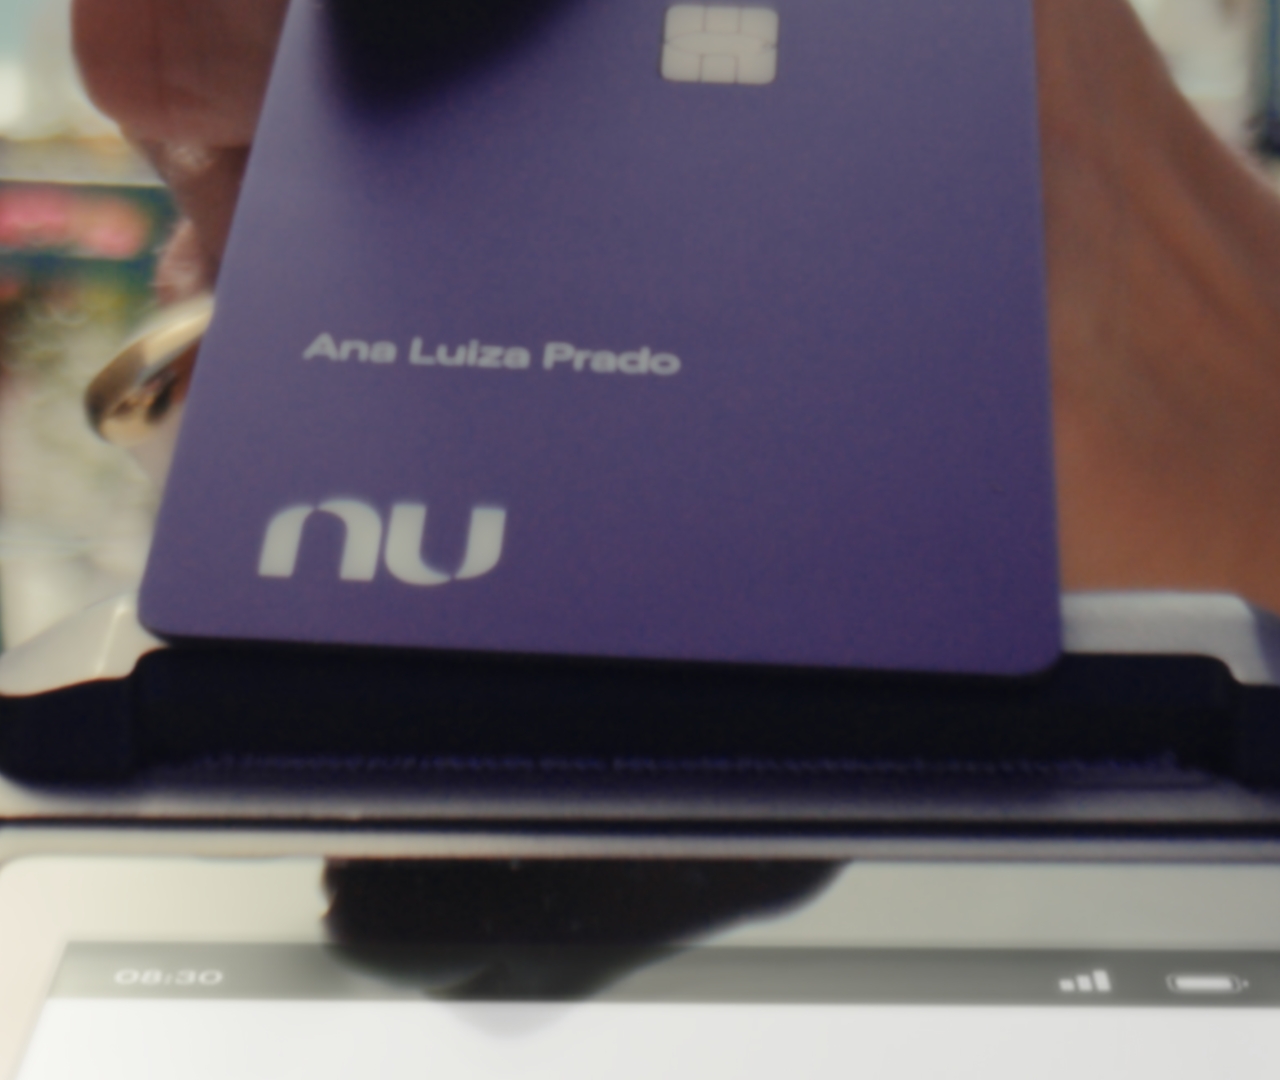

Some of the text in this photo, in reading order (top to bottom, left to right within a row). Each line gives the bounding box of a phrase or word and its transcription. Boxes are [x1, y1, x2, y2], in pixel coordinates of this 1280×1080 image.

[303, 332, 682, 376] Ana Luiza Prado
[113, 967, 224, 987] 08:30
